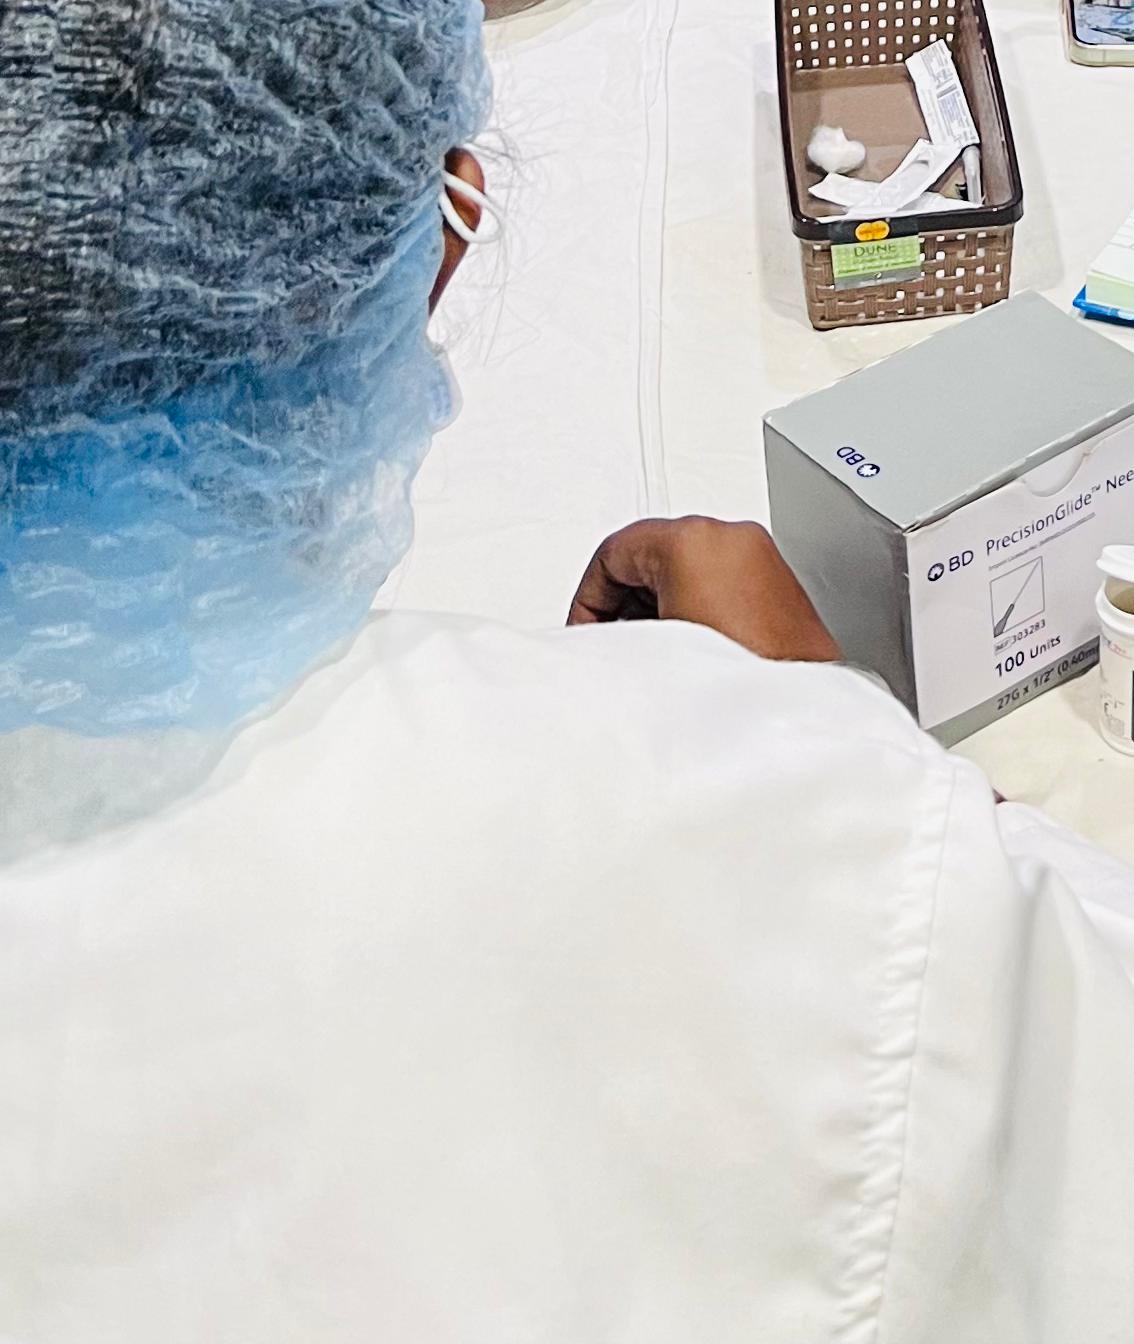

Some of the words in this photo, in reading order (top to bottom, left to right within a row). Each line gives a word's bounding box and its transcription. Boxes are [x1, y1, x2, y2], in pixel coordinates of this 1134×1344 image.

[854, 244, 896, 257] DUNE
[836, 445, 865, 466] BD
[948, 549, 974, 572] BD
[1011, 619, 1046, 646] 303283
[995, 651, 1025, 678] 100
[1029, 634, 1062, 660] Units
[997, 688, 1020, 710] 27G
